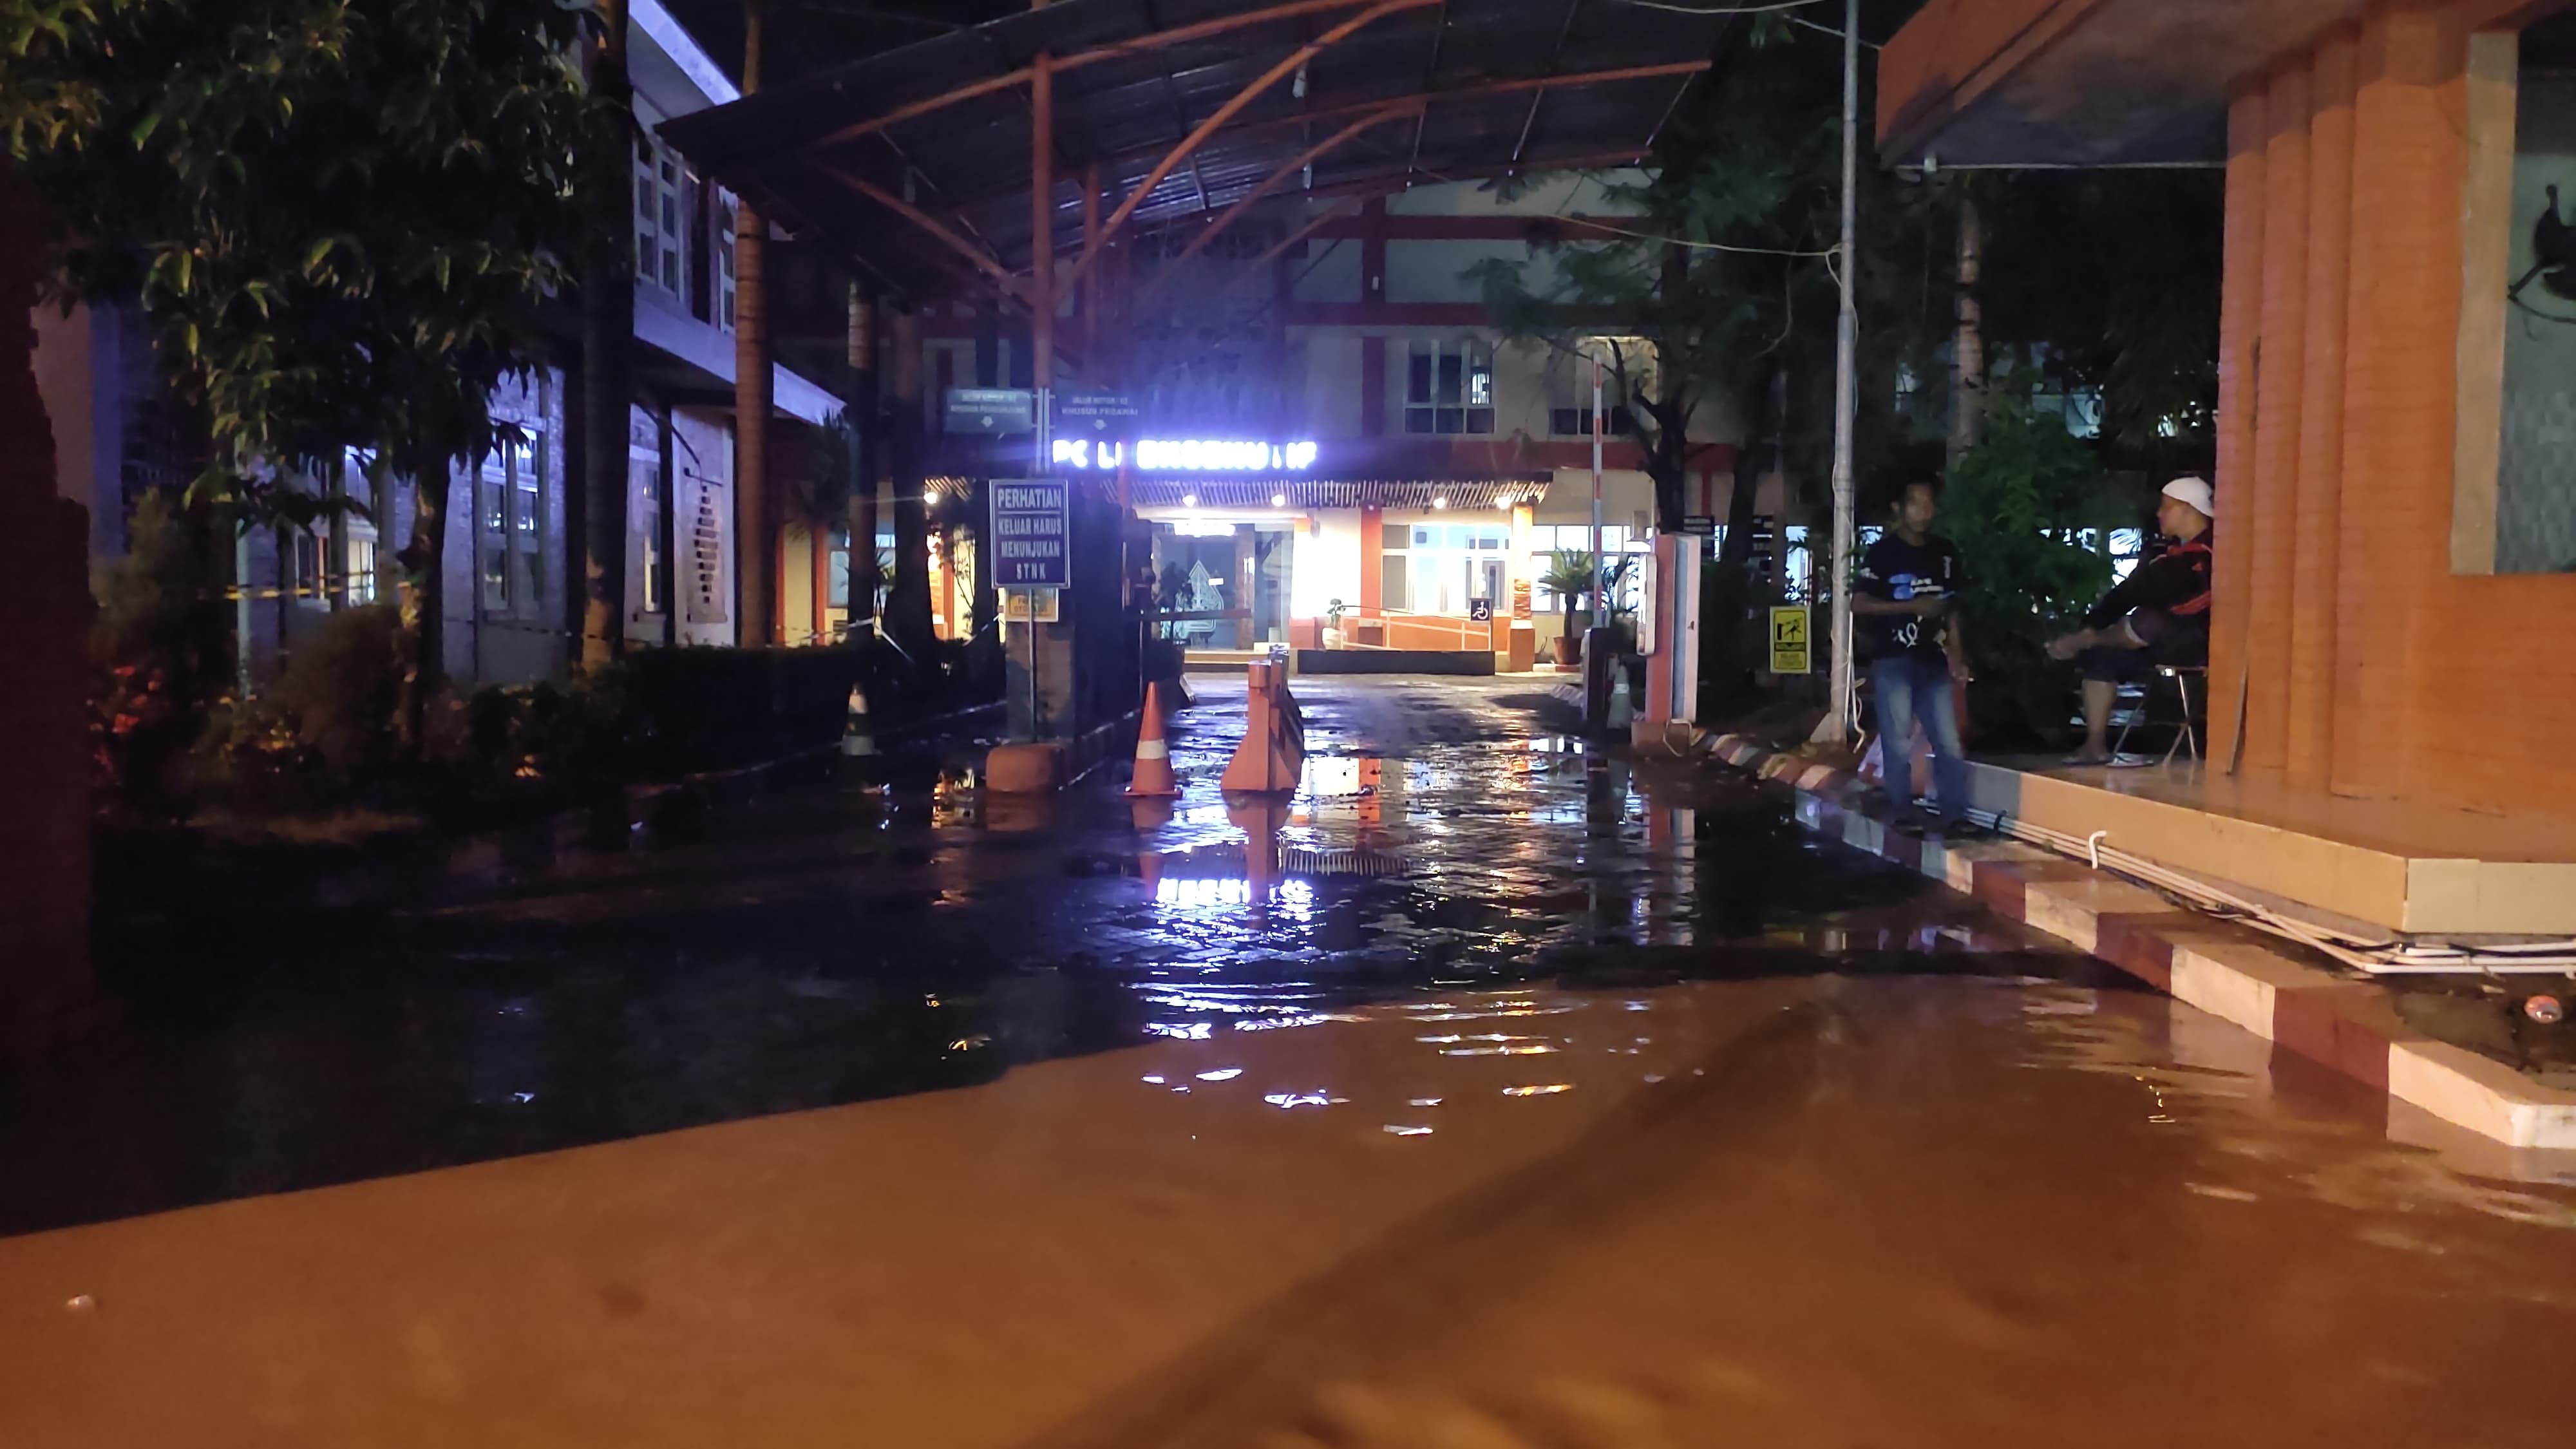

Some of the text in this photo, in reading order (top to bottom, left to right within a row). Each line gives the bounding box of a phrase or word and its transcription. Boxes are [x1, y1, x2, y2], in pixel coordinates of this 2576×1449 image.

[998, 488, 1062, 508] PERHATIAN
[998, 518, 1062, 535] KELUAR HARUS
[1001, 541, 1060, 558] MENUNJUKAN
